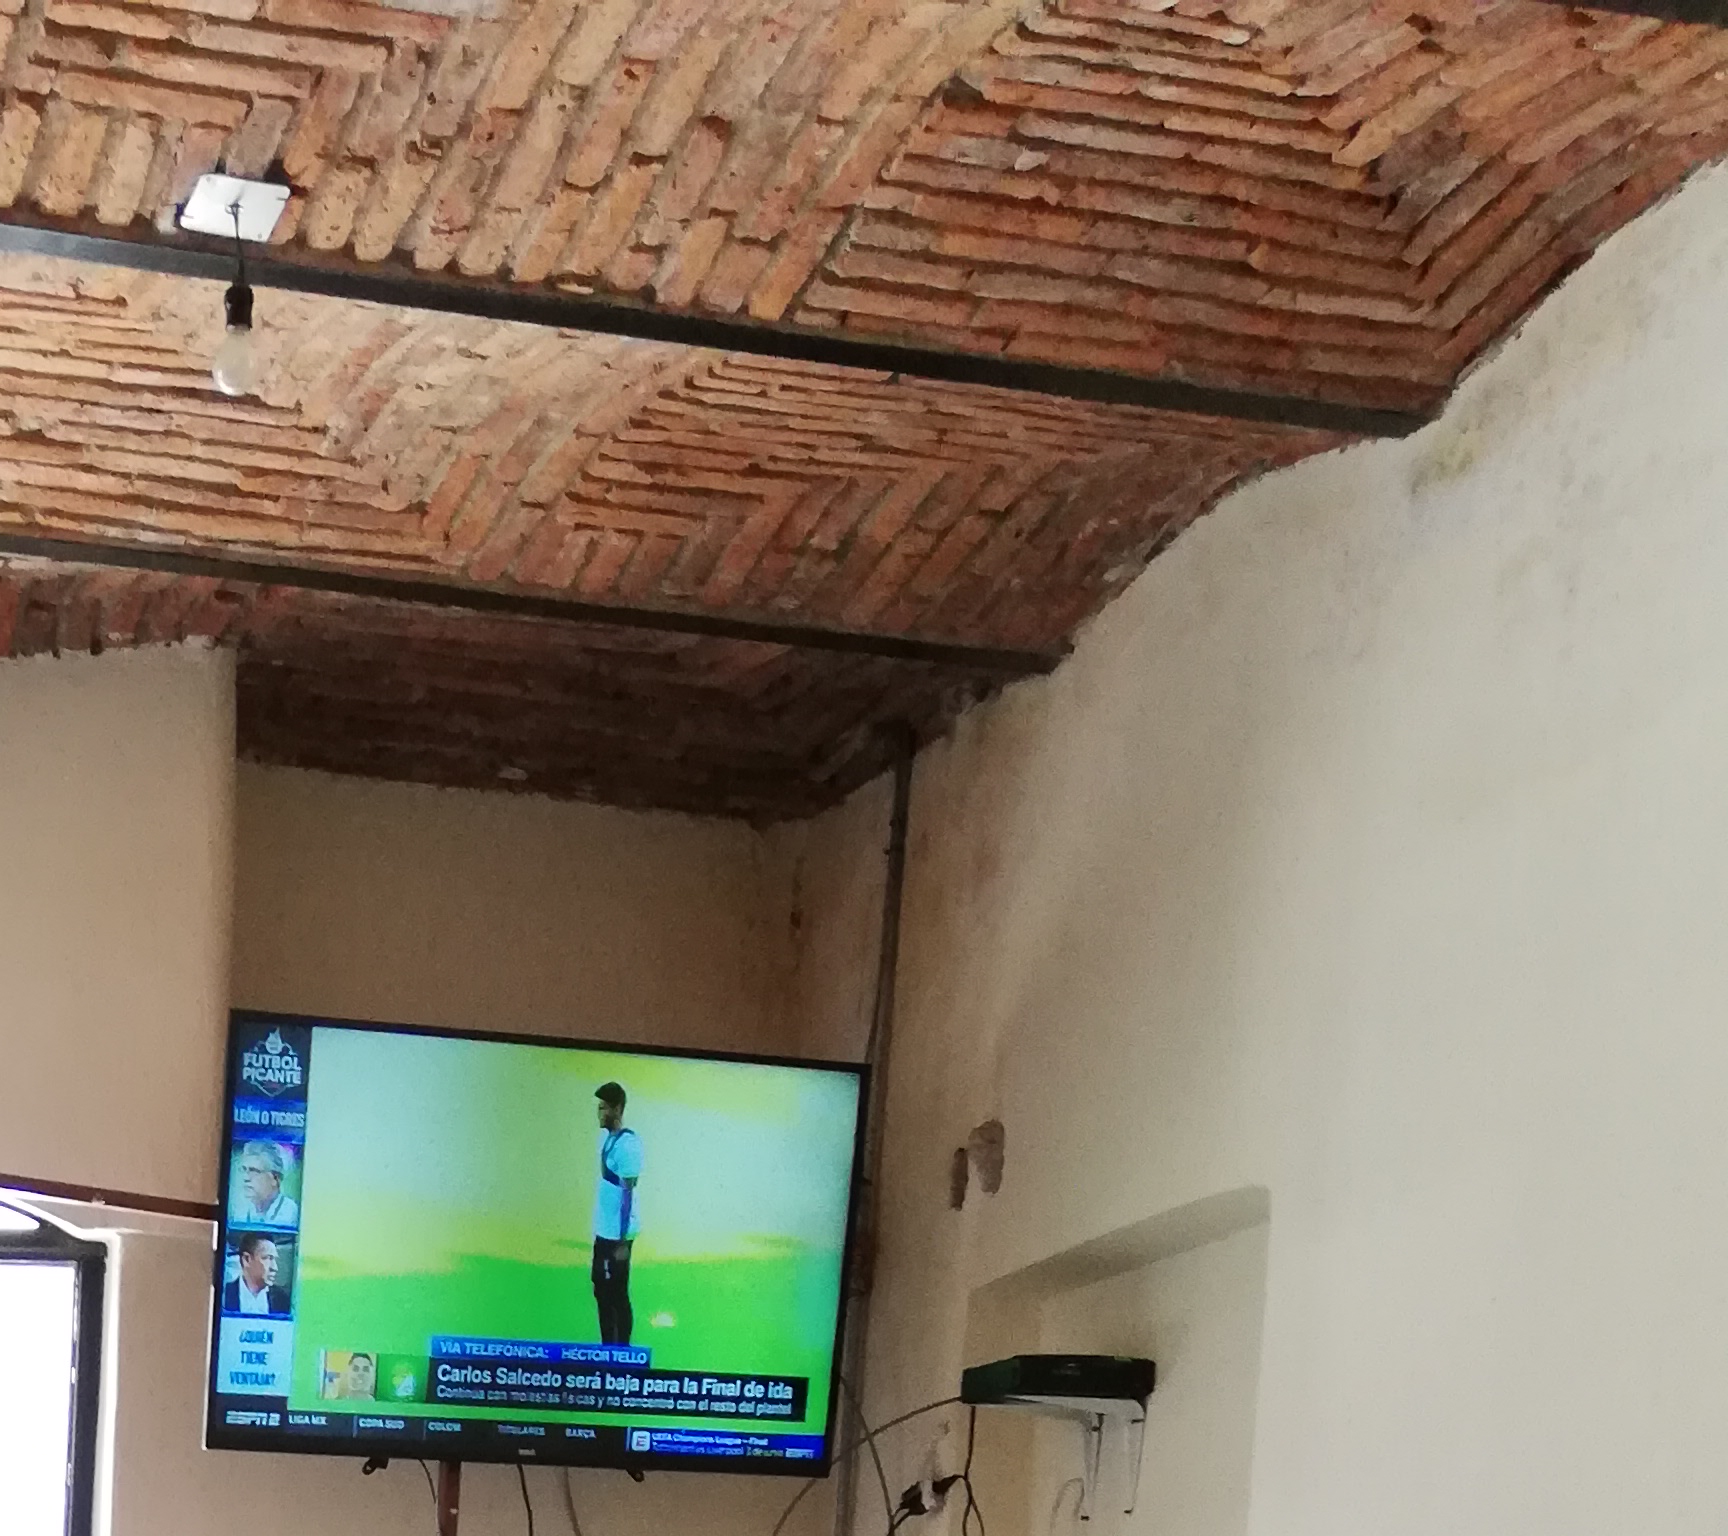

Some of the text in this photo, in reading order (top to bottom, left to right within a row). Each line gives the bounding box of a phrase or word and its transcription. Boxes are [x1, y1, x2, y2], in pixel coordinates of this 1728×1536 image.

[242, 1052, 303, 1071] FUTBOL
[242, 1067, 302, 1084] PICANTE
[612, 1350, 647, 1364] TELLO
[437, 1364, 793, 1399] Carlos Salcedo será baja para la Final de ida
